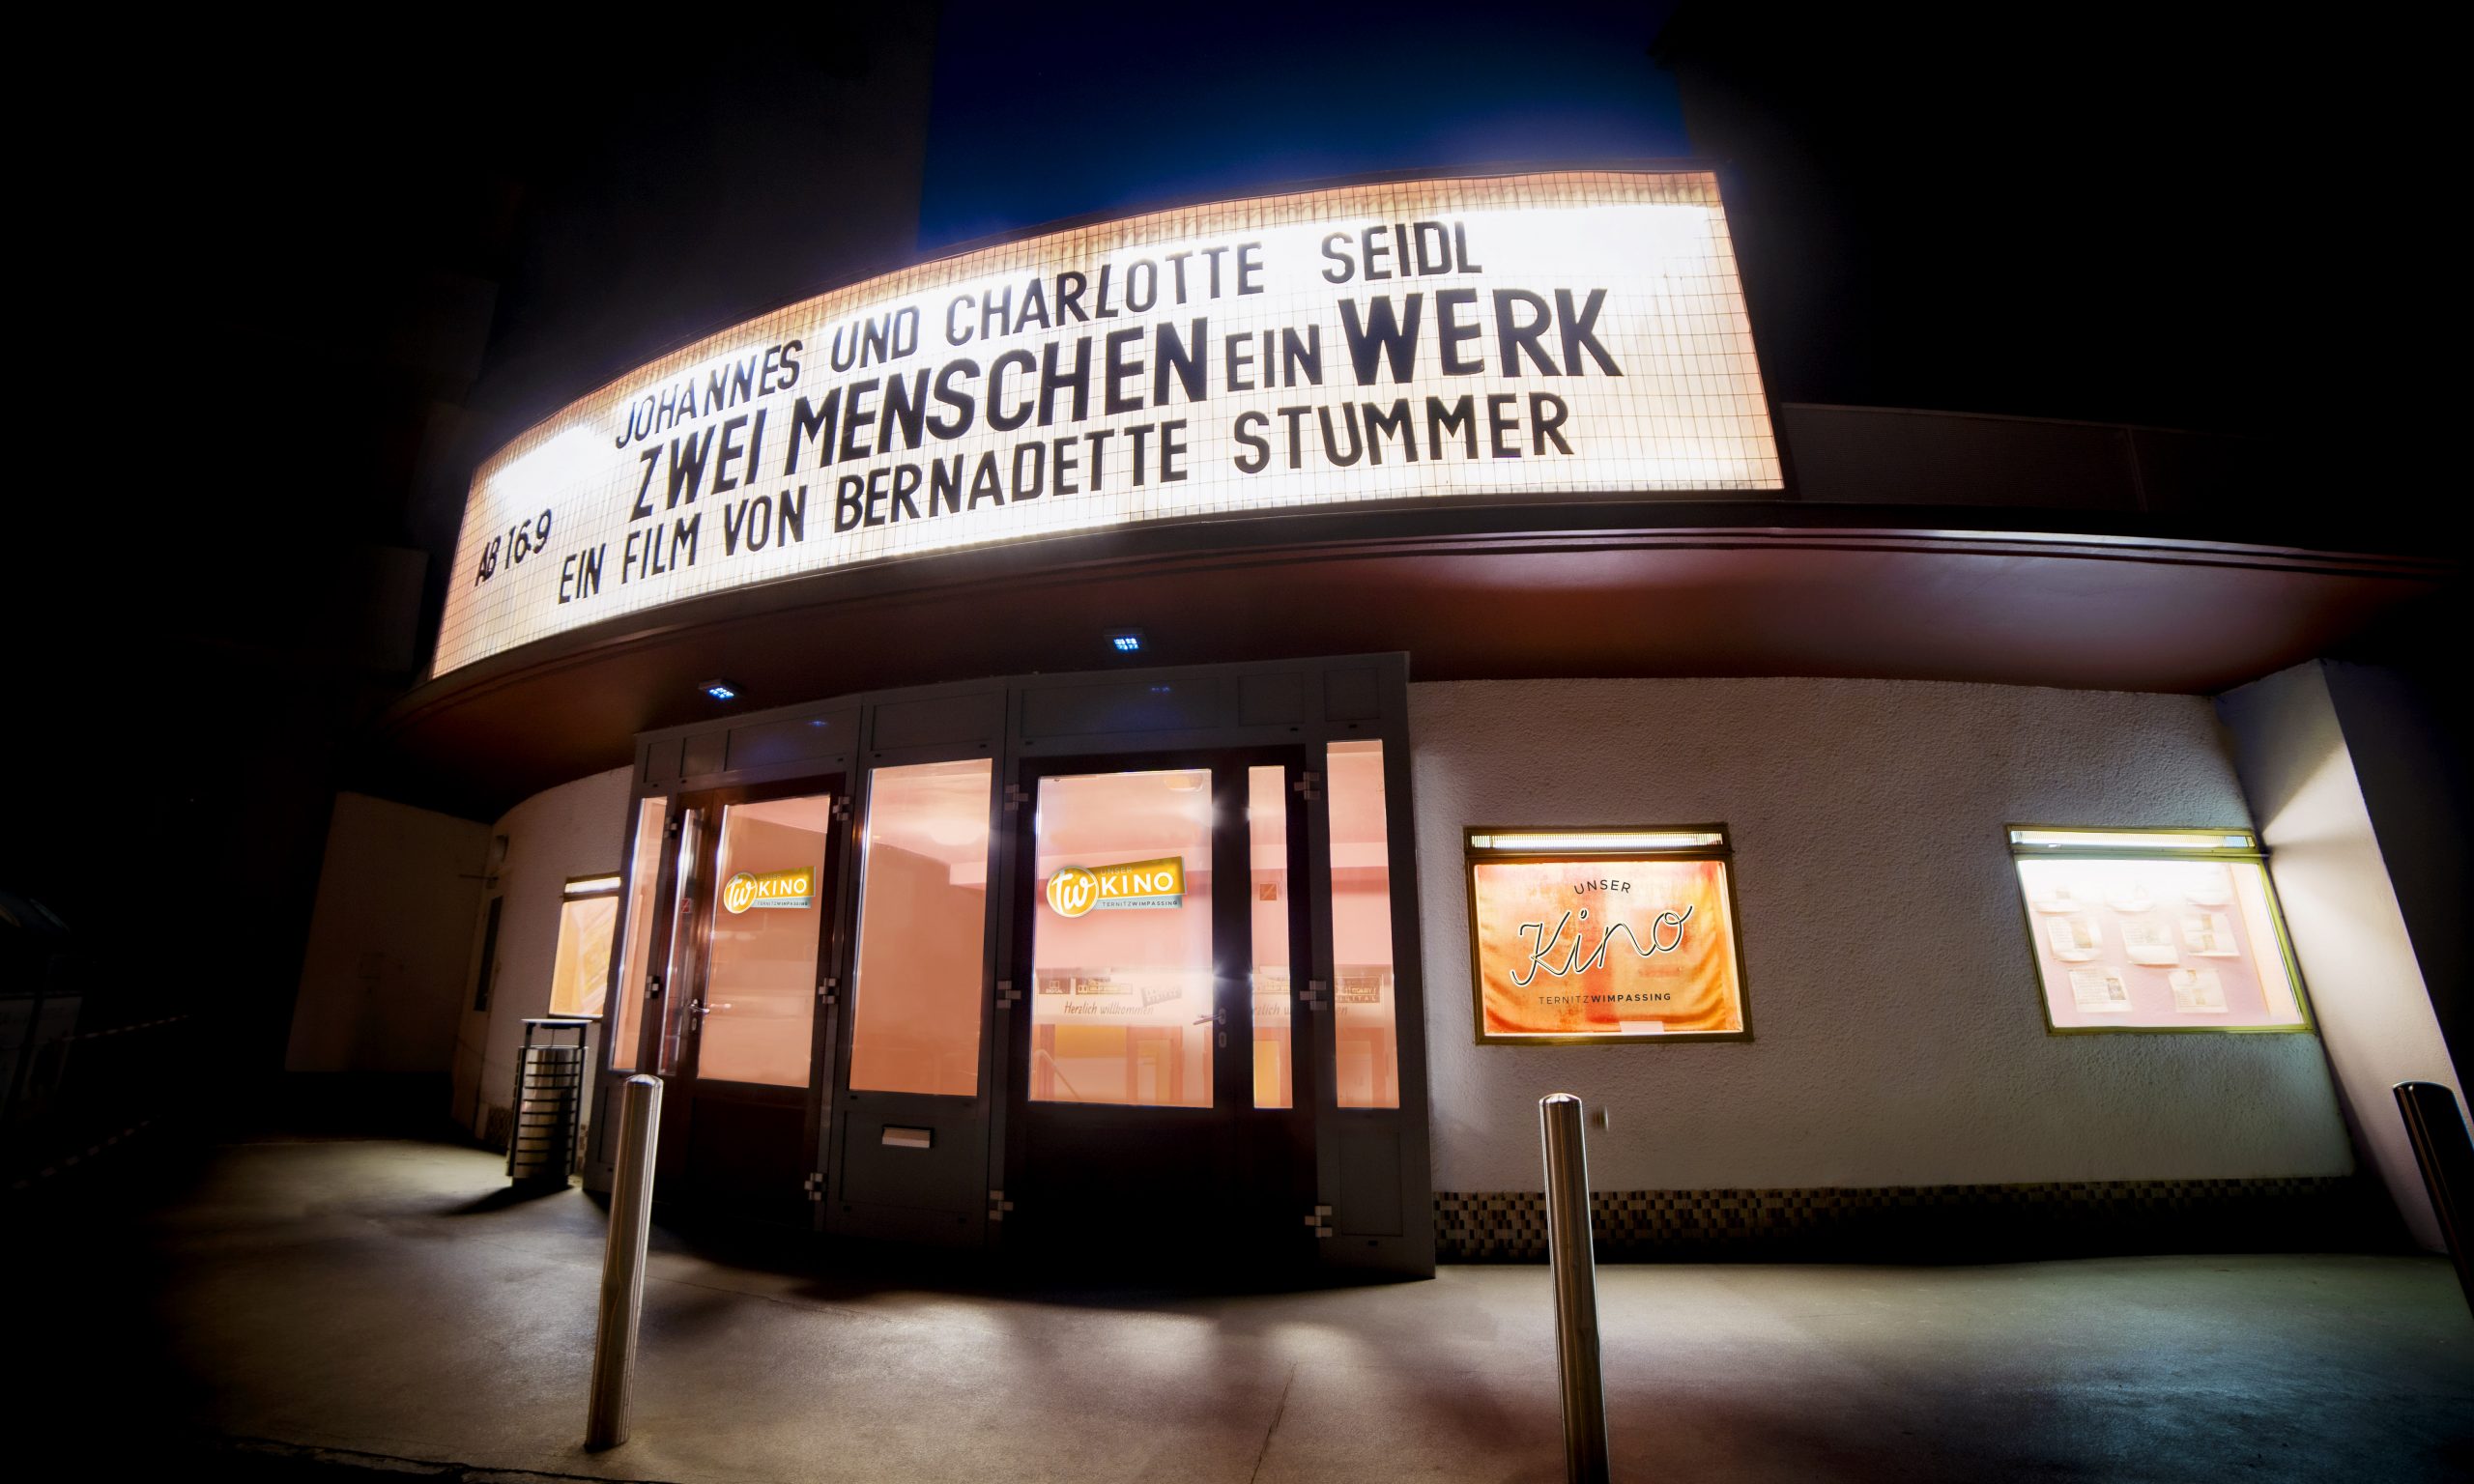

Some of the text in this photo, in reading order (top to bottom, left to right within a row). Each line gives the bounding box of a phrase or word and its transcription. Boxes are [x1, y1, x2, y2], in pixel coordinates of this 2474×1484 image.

[616, 220, 1482, 448] JOHANNES UND CHARLOTTE SEIDL
[630, 288, 1624, 523] ZWEI MENSCHEN EIN WERK
[558, 391, 1574, 605] EIN FILM VON BERNADETTE STUMMER
[475, 534, 502, 587] AB
[759, 877, 807, 897] KINO
[1101, 871, 1174, 897] KINO
[1573, 879, 1631, 895] UNSER
[1102, 899, 1178, 908] TERNITZWIMPASSING
[1511, 904, 1693, 986] Kino
[1064, 1000, 1154, 1015] Herzlich willkommen
[1538, 992, 1672, 1006] TERNITZWIMPASSING
